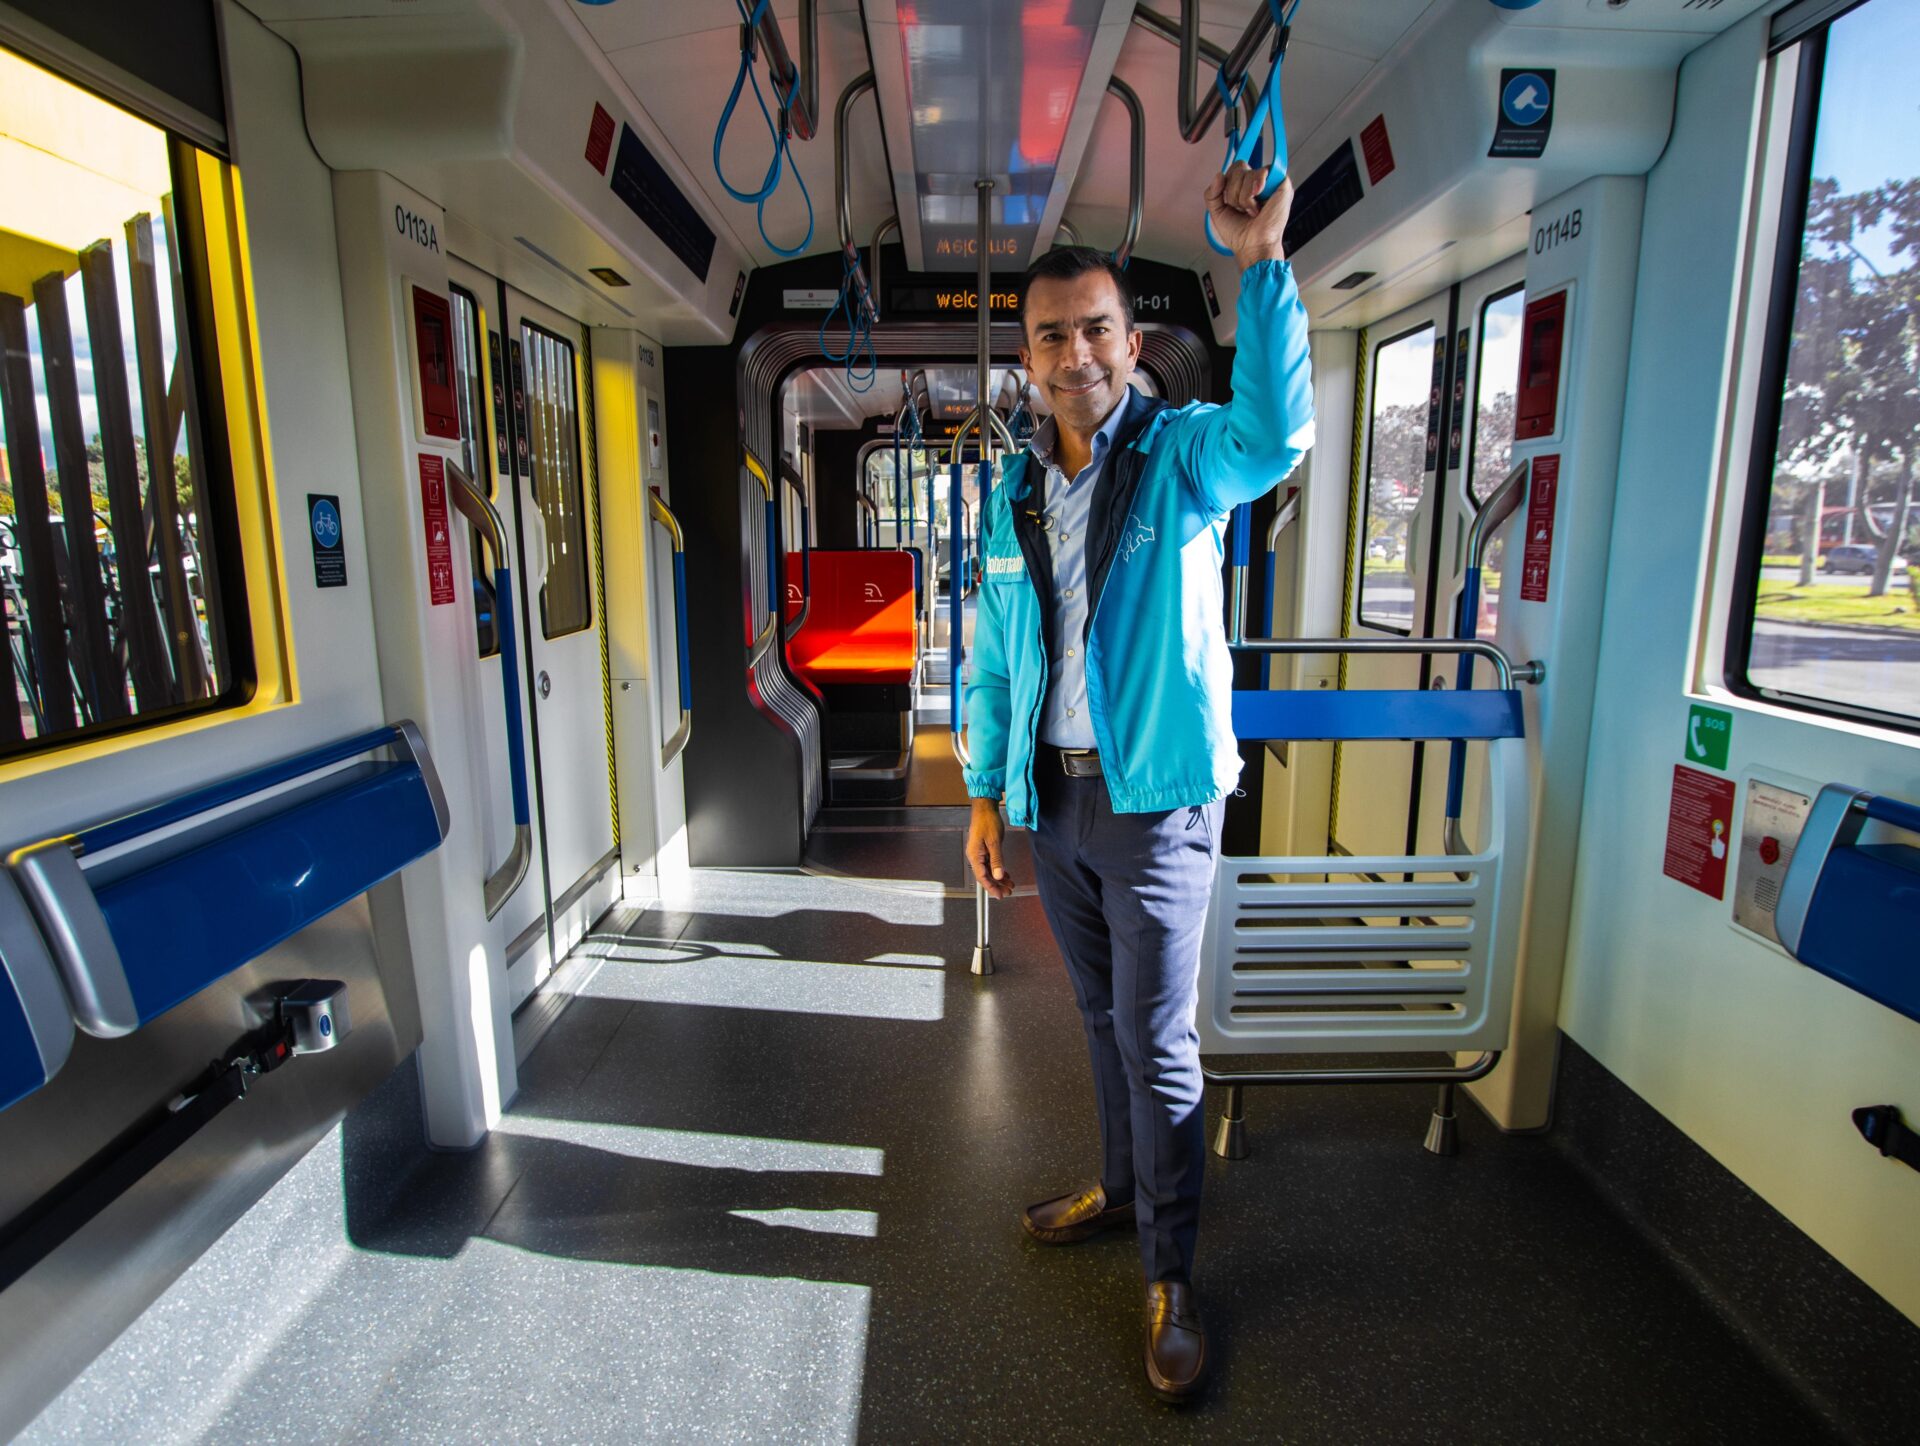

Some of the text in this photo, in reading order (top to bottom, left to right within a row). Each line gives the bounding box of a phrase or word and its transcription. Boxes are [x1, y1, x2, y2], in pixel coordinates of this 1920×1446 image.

[395, 204, 440, 254] 0113A
[1535, 208, 1582, 255] 0114B
[936, 289, 1018, 308] welcme
[1133, 295, 1170, 310] 1-01
[1705, 717, 1726, 731] SOS
